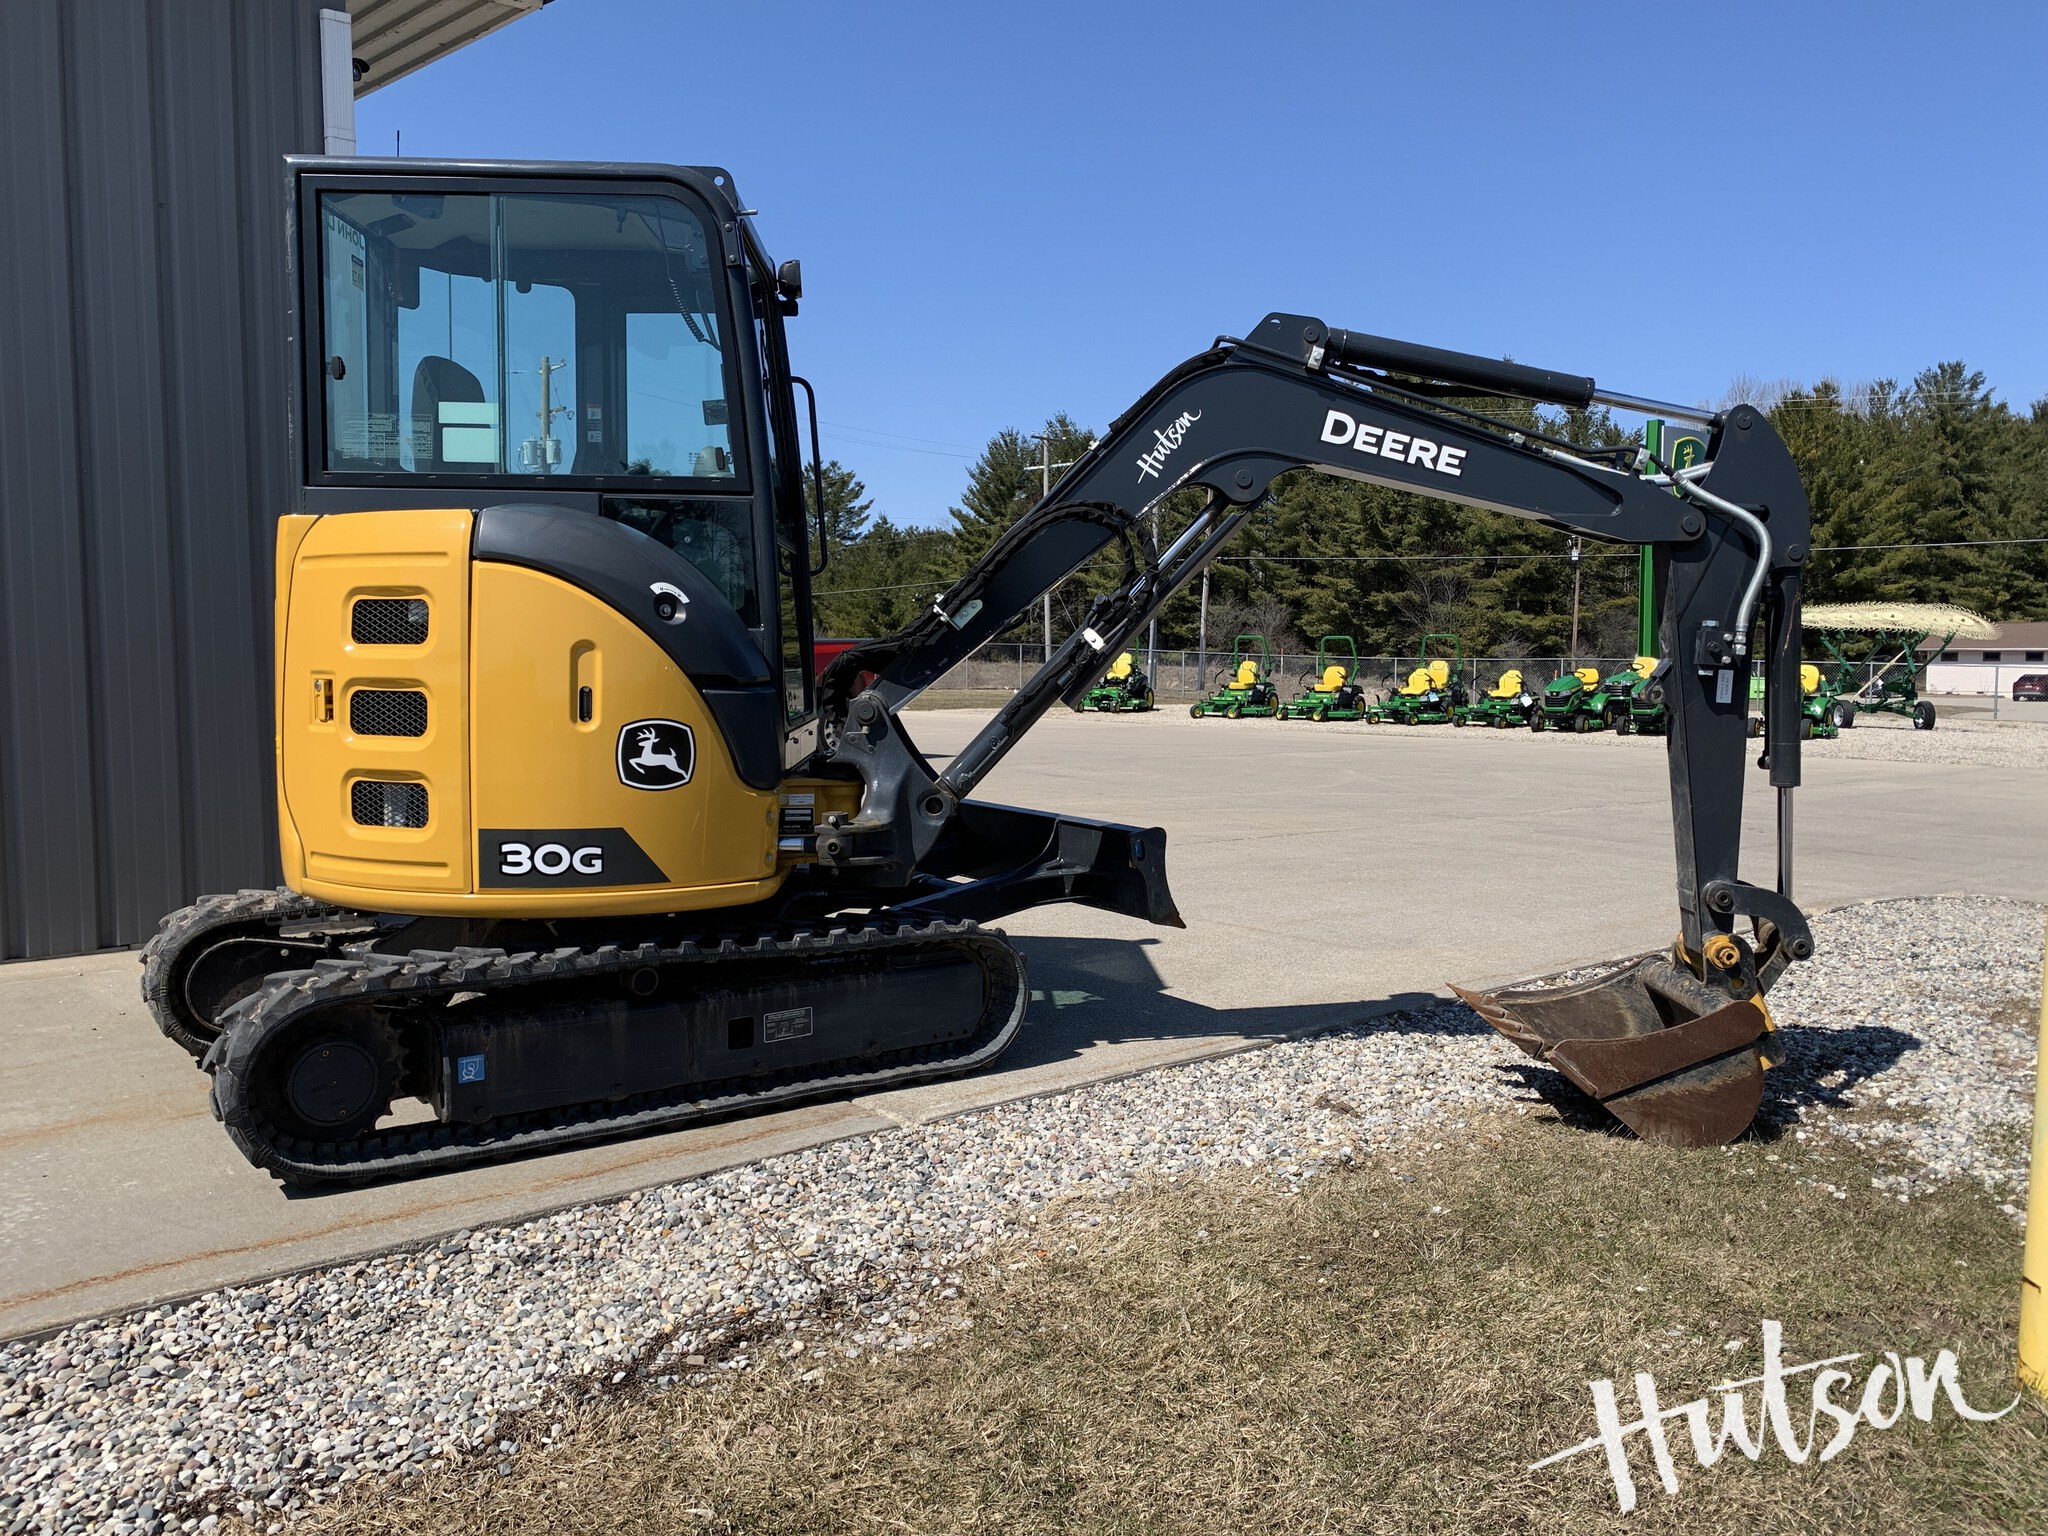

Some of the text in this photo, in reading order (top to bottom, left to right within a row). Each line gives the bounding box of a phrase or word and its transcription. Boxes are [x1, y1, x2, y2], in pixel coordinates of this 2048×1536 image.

[1136, 408, 1202, 484] Hutson
[1320, 409, 1467, 477] DEERE
[500, 843, 603, 875] 30G
